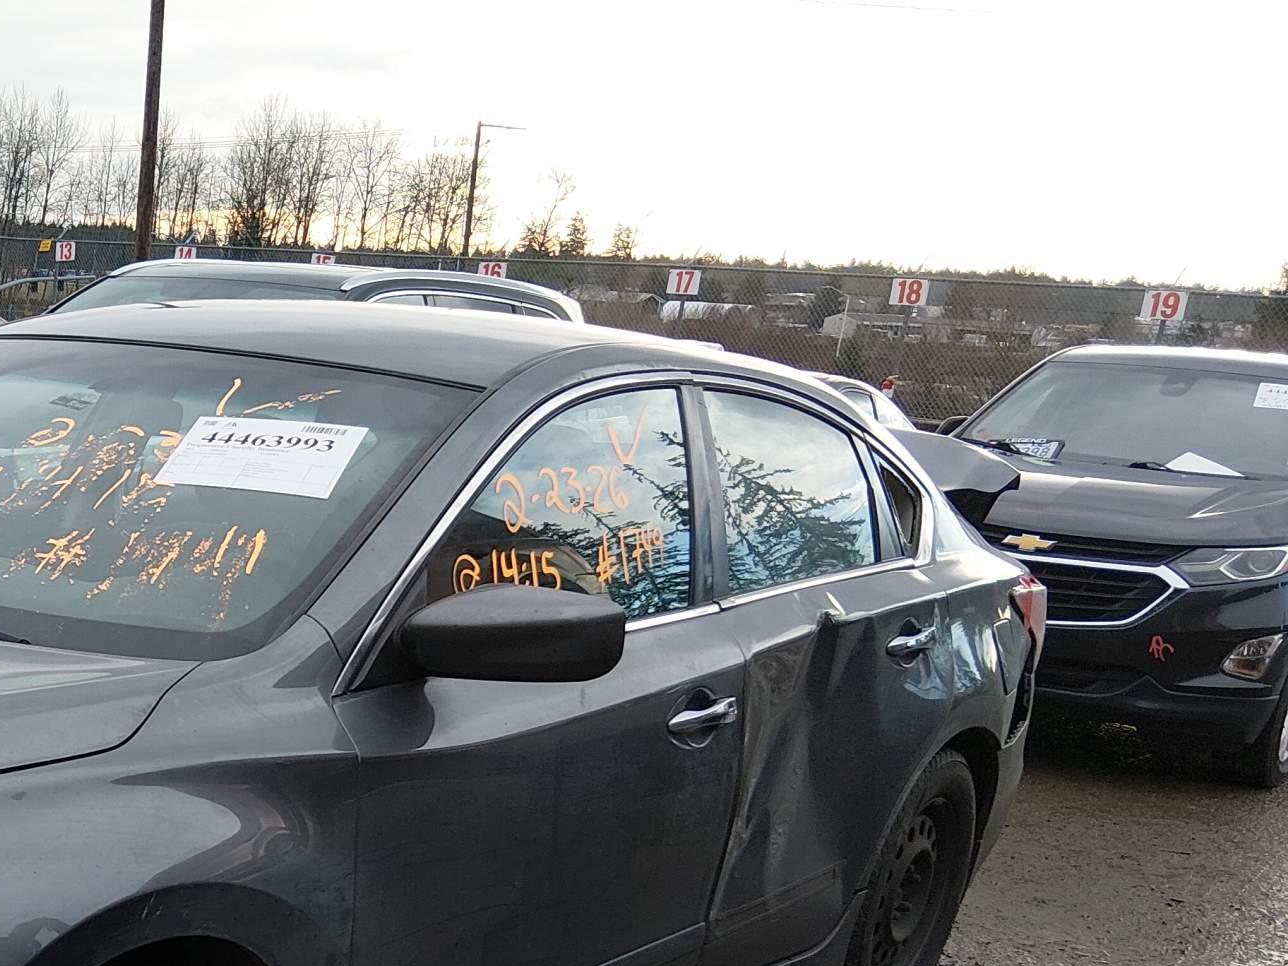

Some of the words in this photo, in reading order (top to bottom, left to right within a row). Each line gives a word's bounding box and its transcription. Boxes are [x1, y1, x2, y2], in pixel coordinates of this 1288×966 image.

[59, 243, 73, 260] 13
[482, 262, 501, 278] 16
[675, 271, 696, 293] 17
[898, 280, 922, 304] 18
[1150, 292, 1180, 318] 19
[201, 432, 335, 451] 44463993
